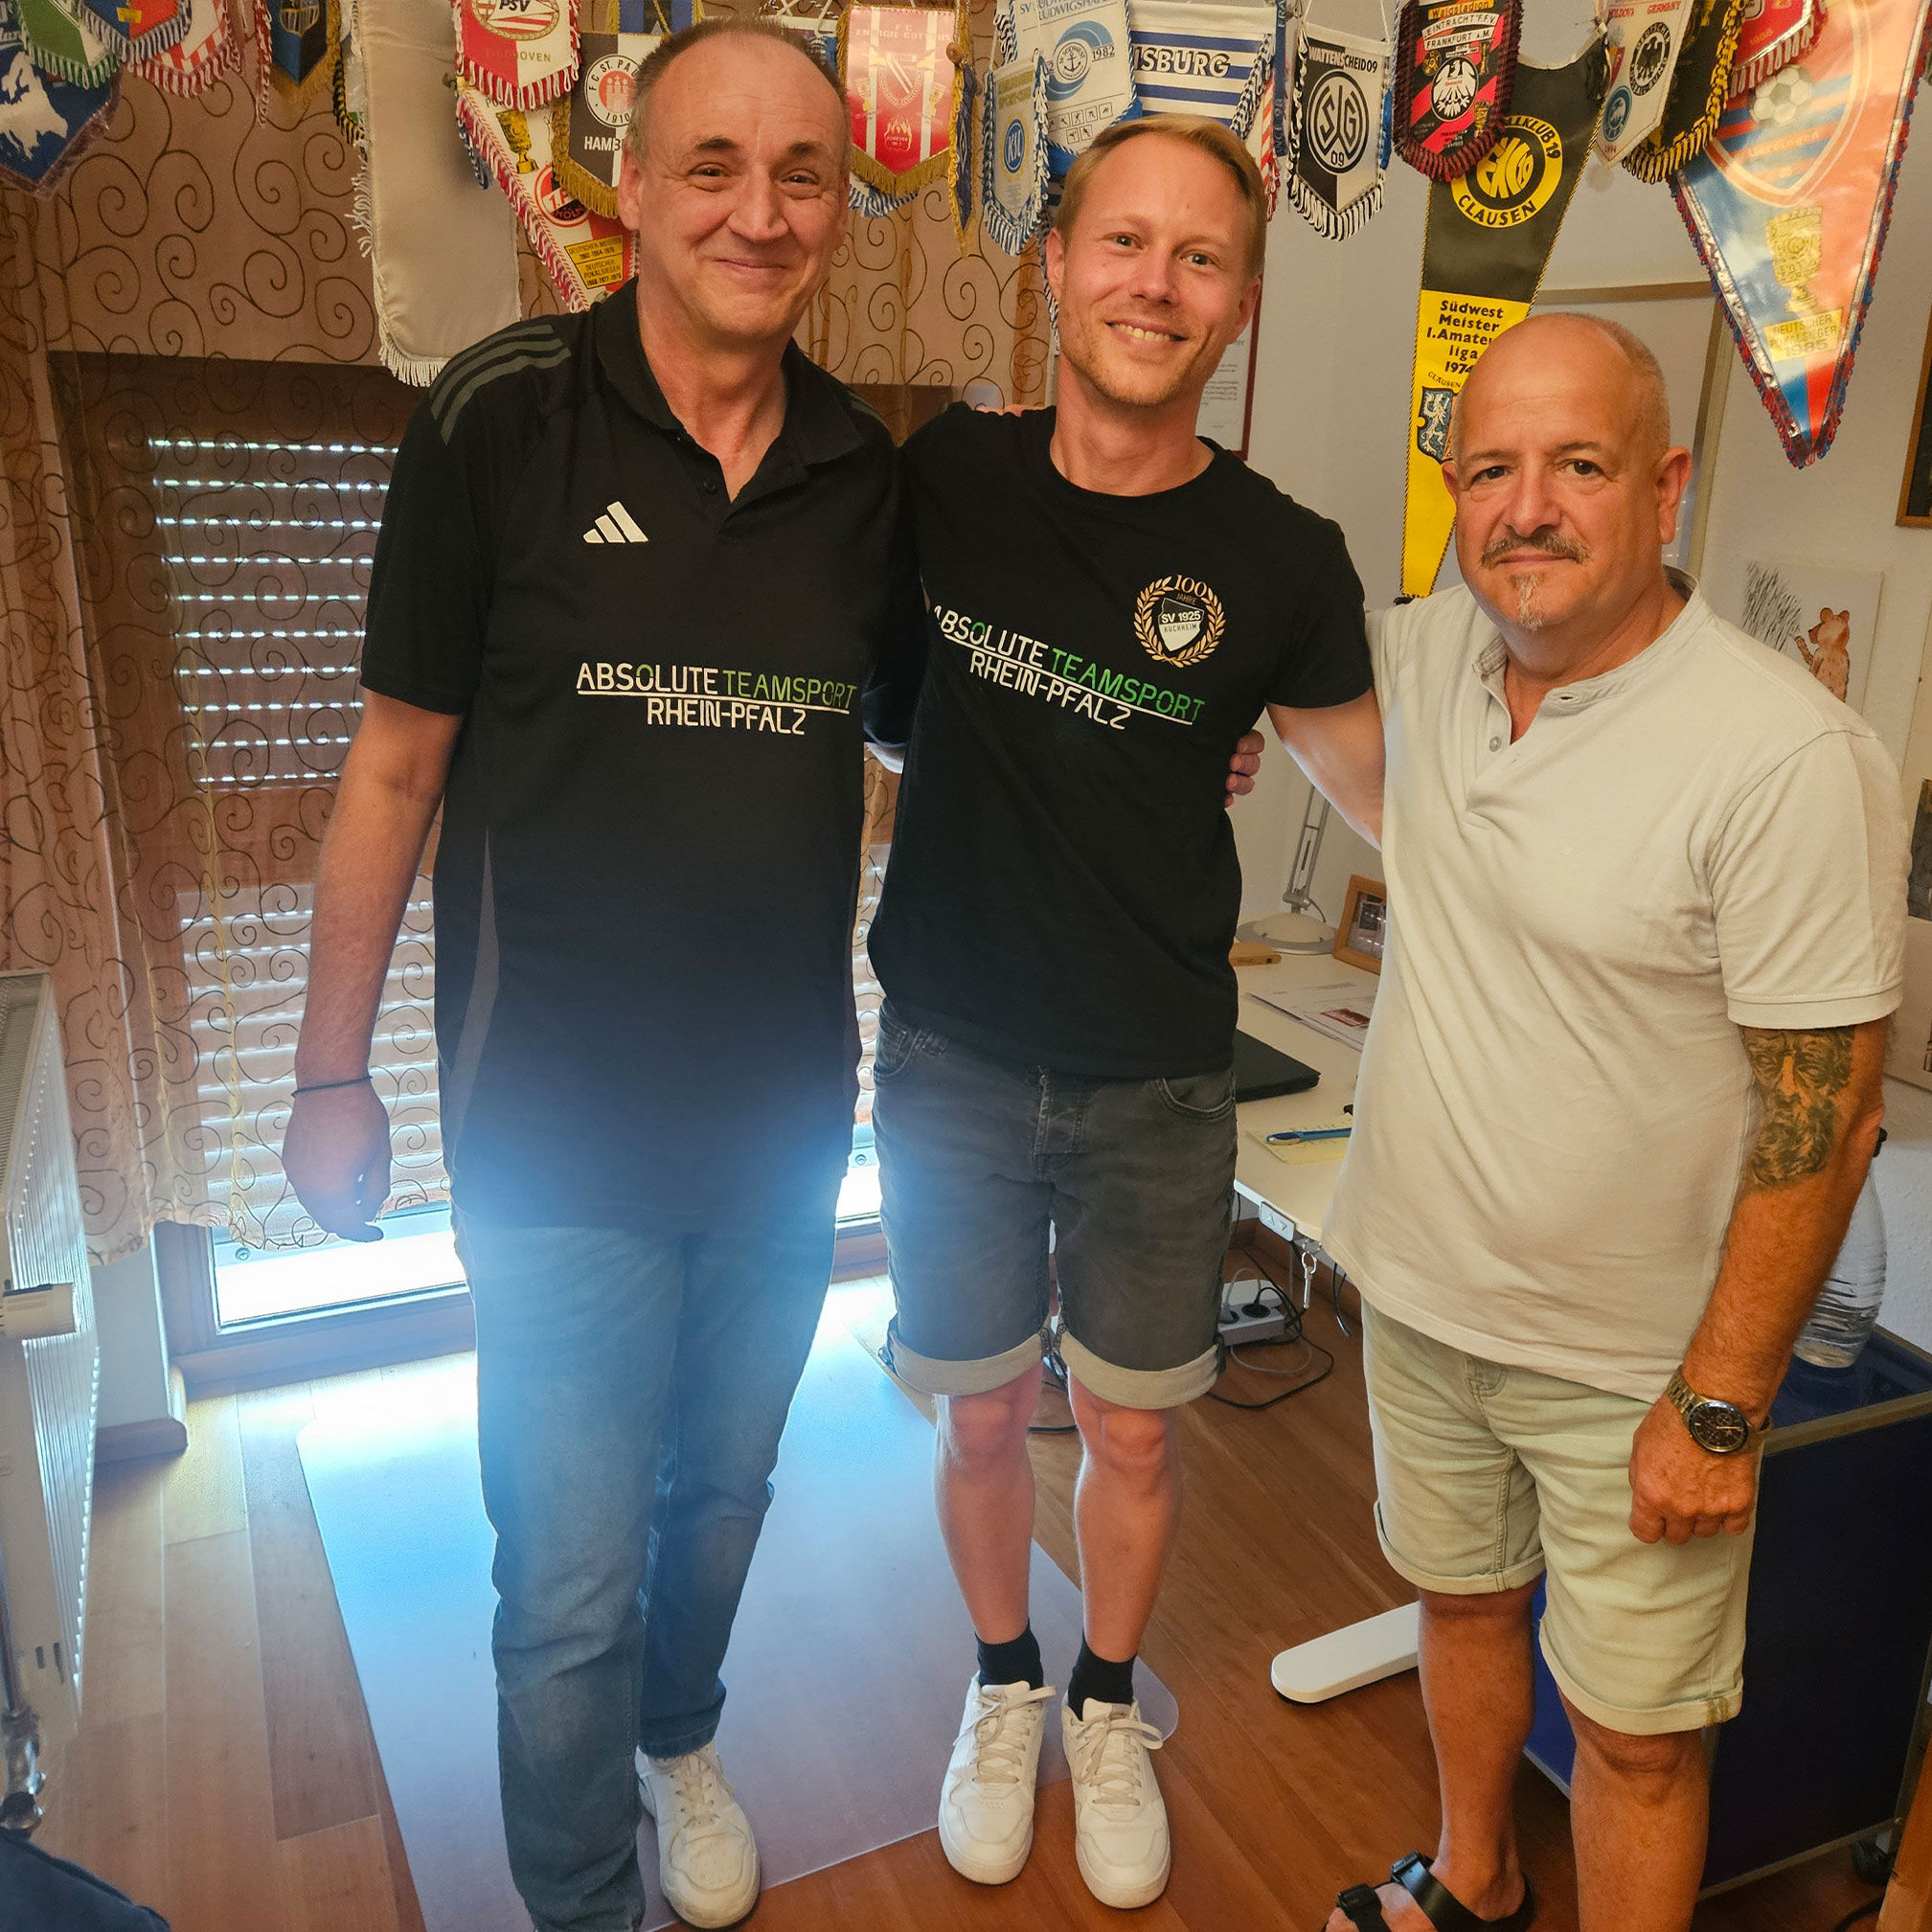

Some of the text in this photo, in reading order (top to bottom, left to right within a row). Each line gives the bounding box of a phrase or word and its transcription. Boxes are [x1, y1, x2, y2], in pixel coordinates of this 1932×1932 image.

[1647, 1, 1681, 14] GERMANY
[1426, 33, 1472, 49] FRANKFURT
[1092, 45, 1115, 60] 1982
[617, 58, 641, 78] PAU
[1132, 46, 1230, 78] ISBURG
[604, 111, 631, 125] 1910
[583, 135, 621, 151] HAMB
[1330, 149, 1345, 167] 09
[1458, 194, 1537, 226] CLAUSEN
[1440, 300, 1504, 319] Südwest
[1439, 314, 1500, 331] Meister
[1449, 345, 1478, 361] liga
[1785, 338, 1829, 357] 1985
[1427, 371, 1462, 388] CLAUSEN
[1174, 575, 1207, 597] 100
[1175, 593, 1197, 605] JAHRE
[1161, 611, 1201, 624] SV 1925
[1164, 624, 1197, 633] RUCHHEIM
[576, 662, 857, 709] ABSOLUTE TEAMSPORT
[969, 650, 1131, 730] RHEIN-PFALZ
[1052, 648, 1205, 721] TEAMSPORT
[647, 697, 807, 736] RHEIN-PFALZ
